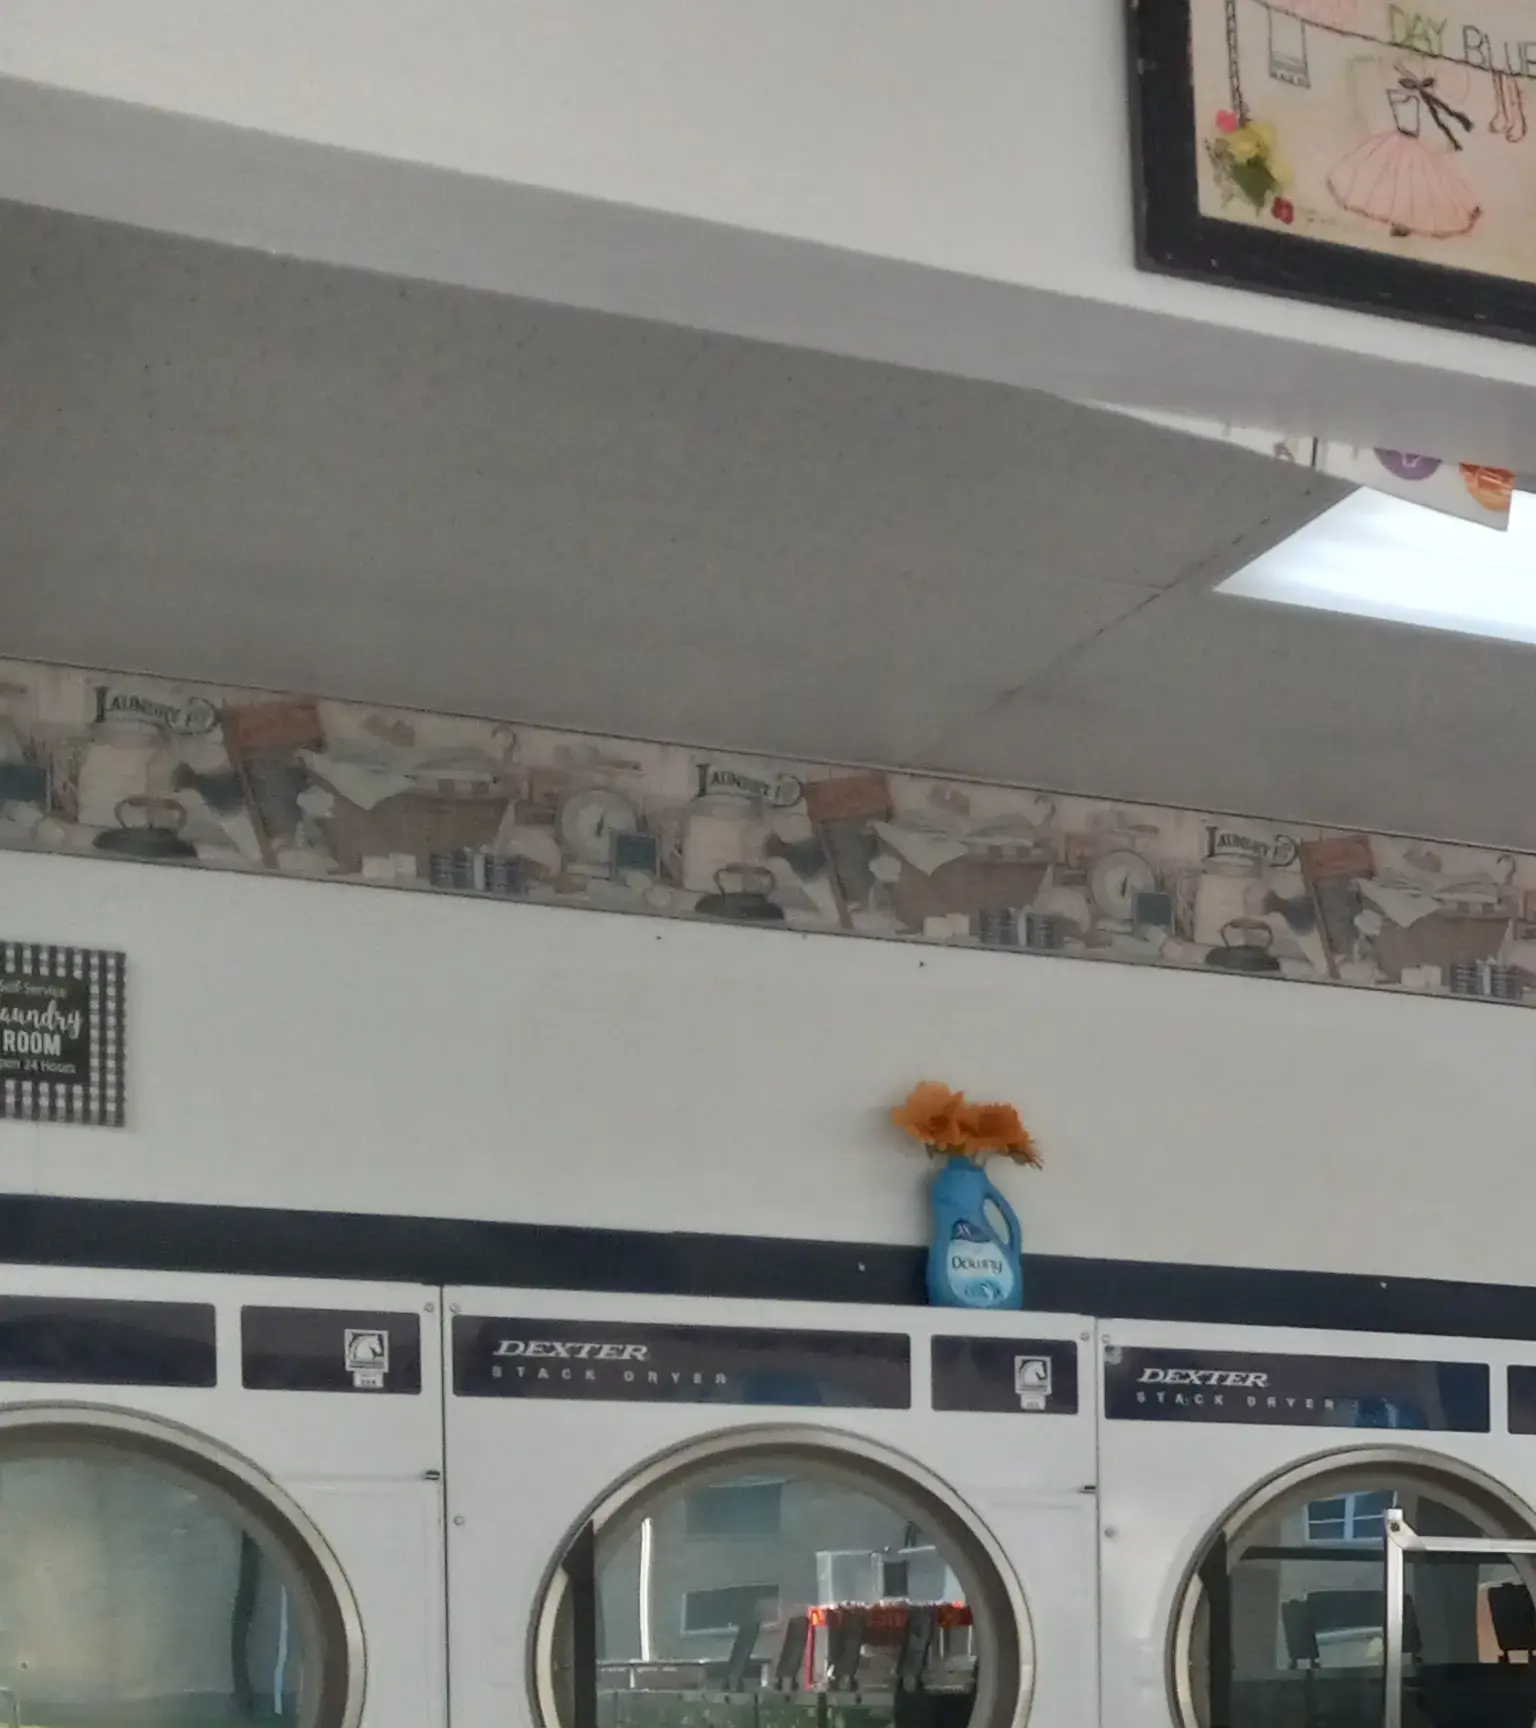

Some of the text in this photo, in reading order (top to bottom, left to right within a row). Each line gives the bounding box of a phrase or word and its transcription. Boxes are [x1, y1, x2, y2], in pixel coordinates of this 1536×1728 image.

[1387, 3, 1447, 55] DAY
[0, 999, 80, 1040] aundry
[3, 1030, 61, 1056] ROOM
[952, 1256, 1002, 1274] Downy
[493, 1340, 649, 1362] DEXTER
[491, 1366, 727, 1385] STACK DRYER
[1137, 1368, 1269, 1388] DEXTER
[1136, 1392, 1335, 1410] STACK DRYER
